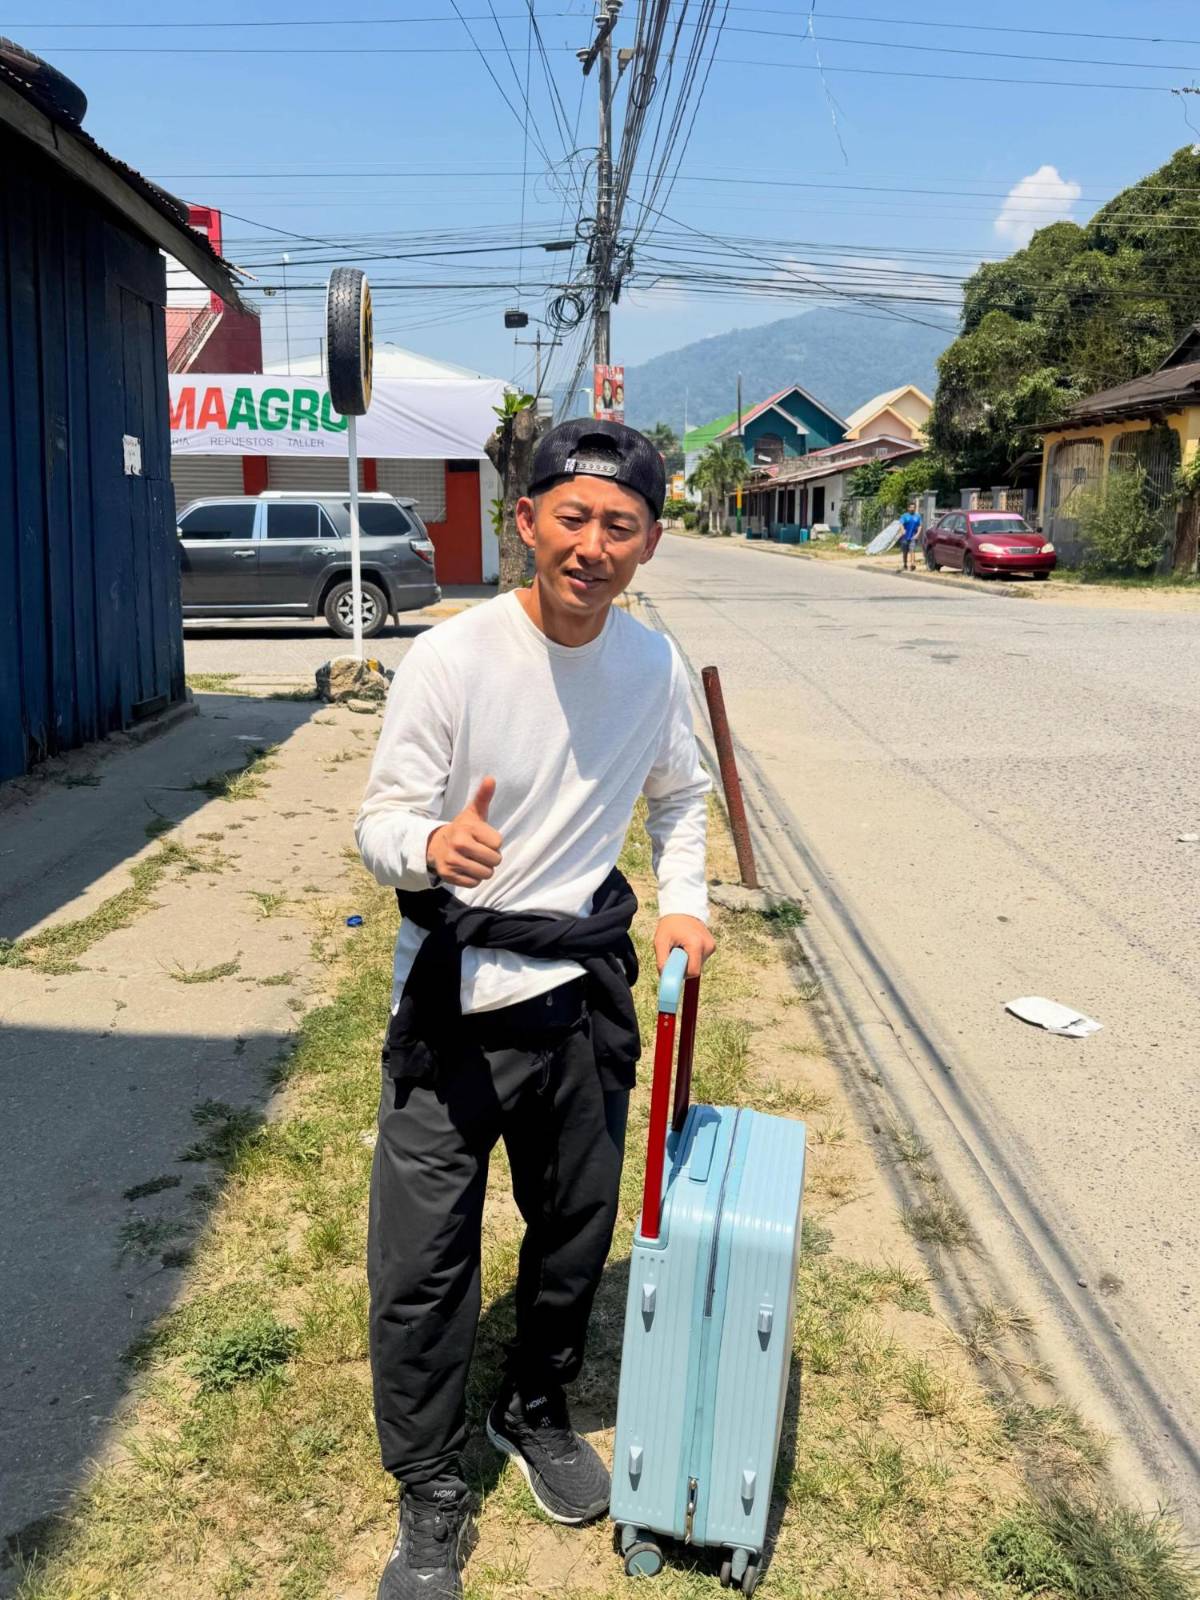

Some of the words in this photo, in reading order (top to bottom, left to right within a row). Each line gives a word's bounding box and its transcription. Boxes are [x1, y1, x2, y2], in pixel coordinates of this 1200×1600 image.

[210, 437, 274, 447] REPUESTOS
[288, 438, 325, 448] TALLER
[432, 1489, 457, 1499] HOKA
